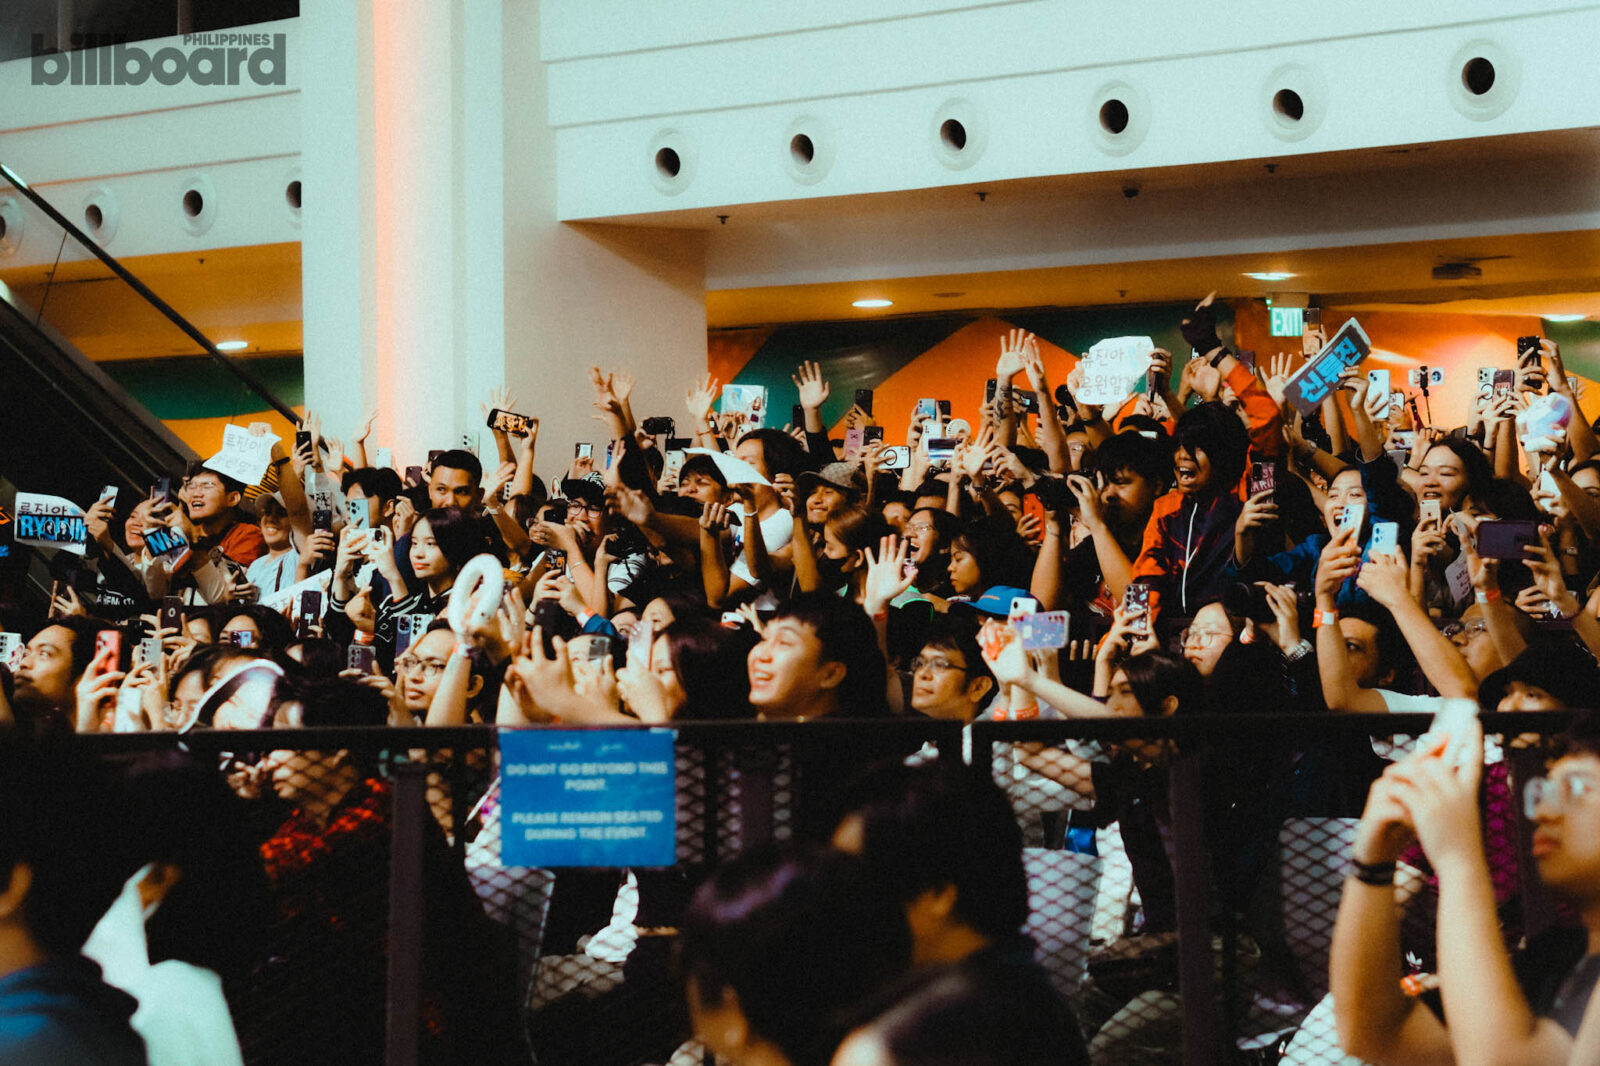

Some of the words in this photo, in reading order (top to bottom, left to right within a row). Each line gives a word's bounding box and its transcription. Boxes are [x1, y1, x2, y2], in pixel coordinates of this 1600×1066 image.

[1272, 308, 1302, 336] EXIT
[1298, 336, 1362, 403] 신류진
[506, 763, 528, 776] DO
[528, 763, 556, 776] NOT
[558, 762, 580, 776] GO
[581, 761, 637, 776] BEYOND
[638, 761, 668, 775] THIS
[511, 811, 558, 825] PLEASE
[560, 810, 612, 824] REMAIN
[614, 809, 664, 823] SEATED
[524, 827, 577, 841] DURING
[579, 826, 602, 840] THE
